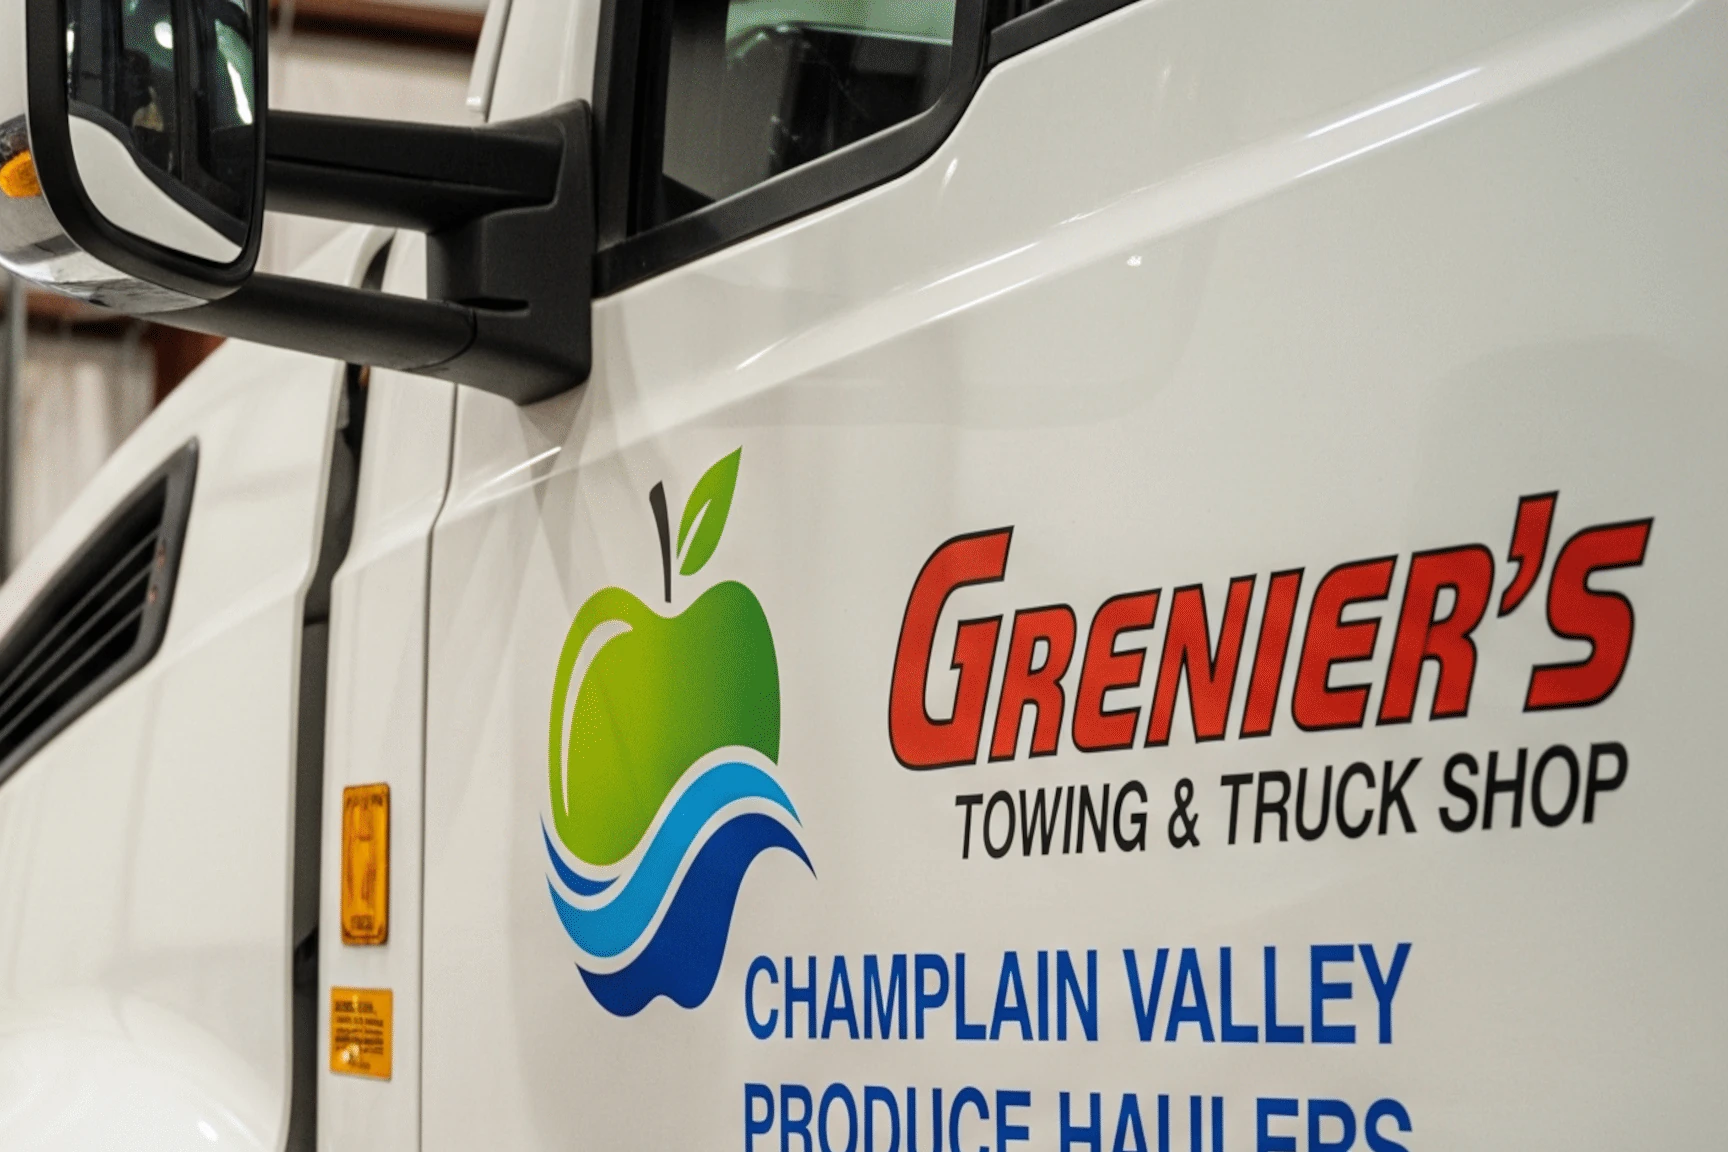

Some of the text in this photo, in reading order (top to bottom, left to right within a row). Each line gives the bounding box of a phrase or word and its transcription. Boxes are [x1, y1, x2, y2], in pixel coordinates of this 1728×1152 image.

[888, 490, 1655, 770] GRENIER'S
[955, 741, 1629, 860] TOWING & TRUCK SHOP
[744, 943, 1412, 1045] CHAMPLAIN VALLEY
